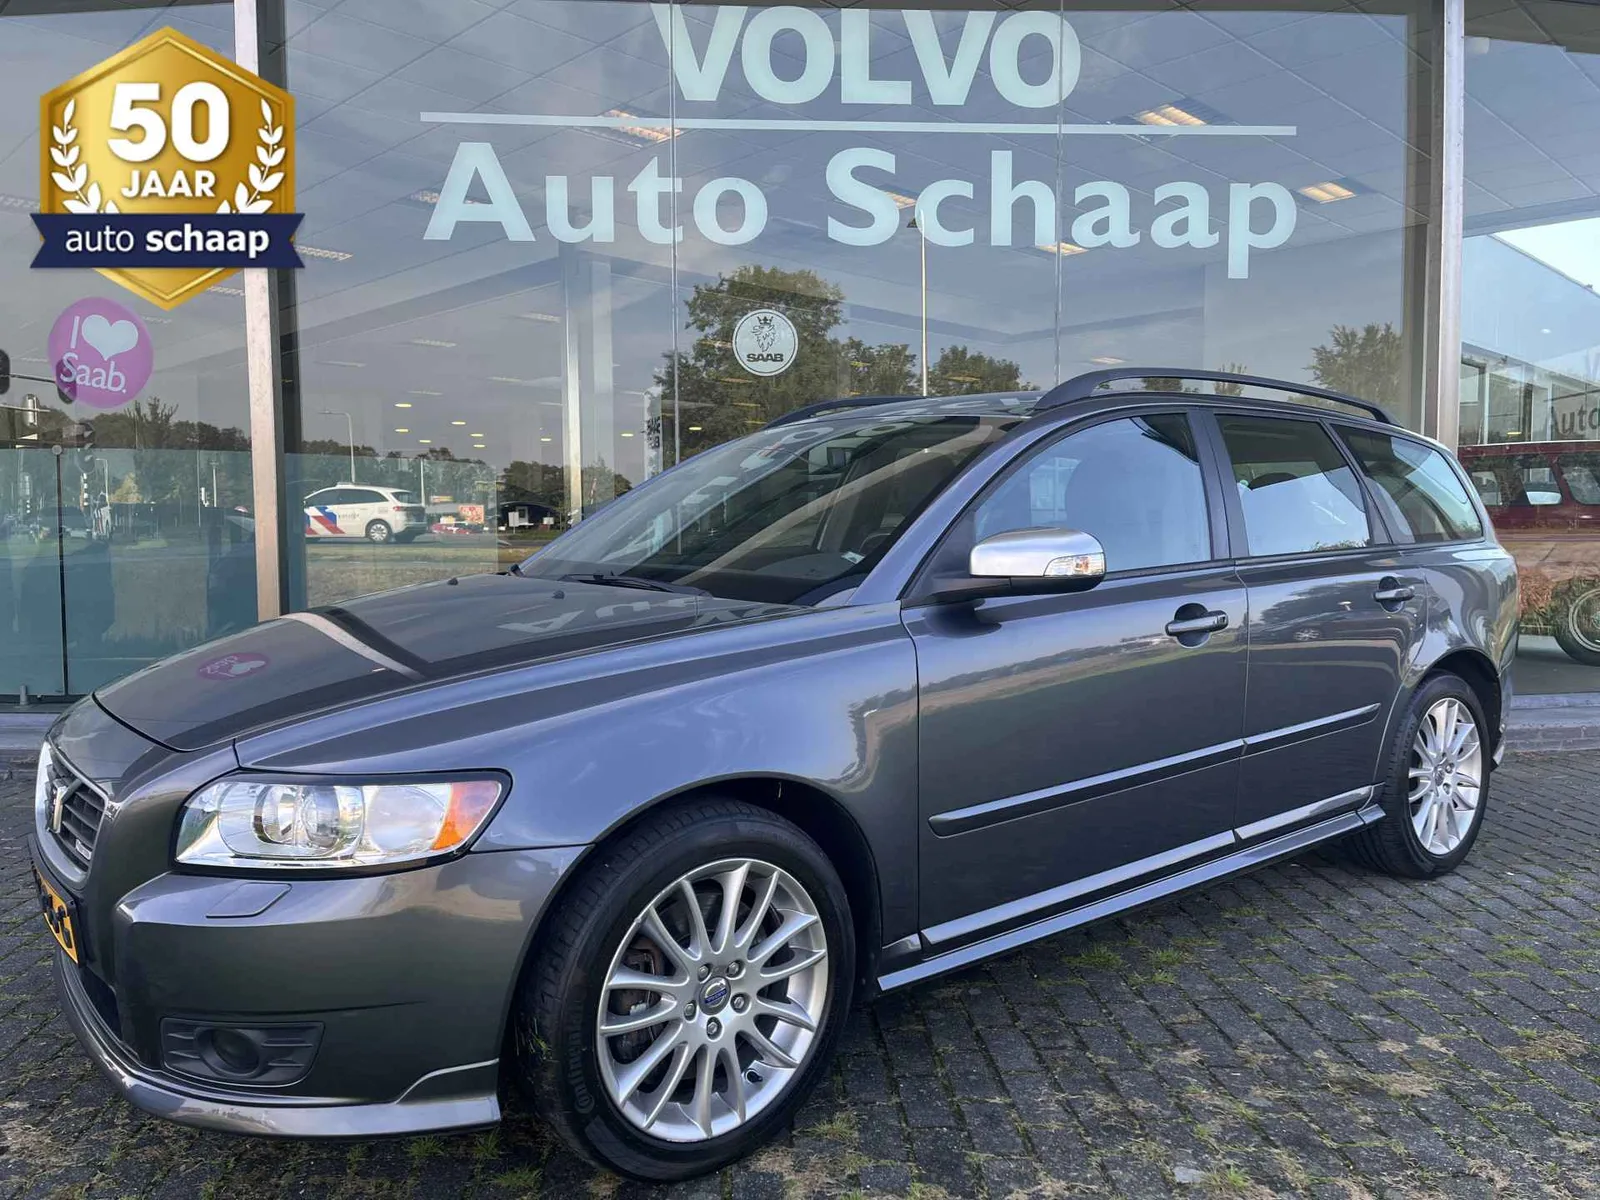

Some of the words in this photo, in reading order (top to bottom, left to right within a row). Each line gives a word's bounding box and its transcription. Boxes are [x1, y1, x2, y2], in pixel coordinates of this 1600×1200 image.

[651, 3, 1081, 108] VOLVO
[423, 142, 768, 246] Auto
[826, 147, 1297, 279] Schaap
[71, 316, 79, 348] I
[60, 353, 126, 394] Saab.
[747, 353, 784, 362] SAAB
